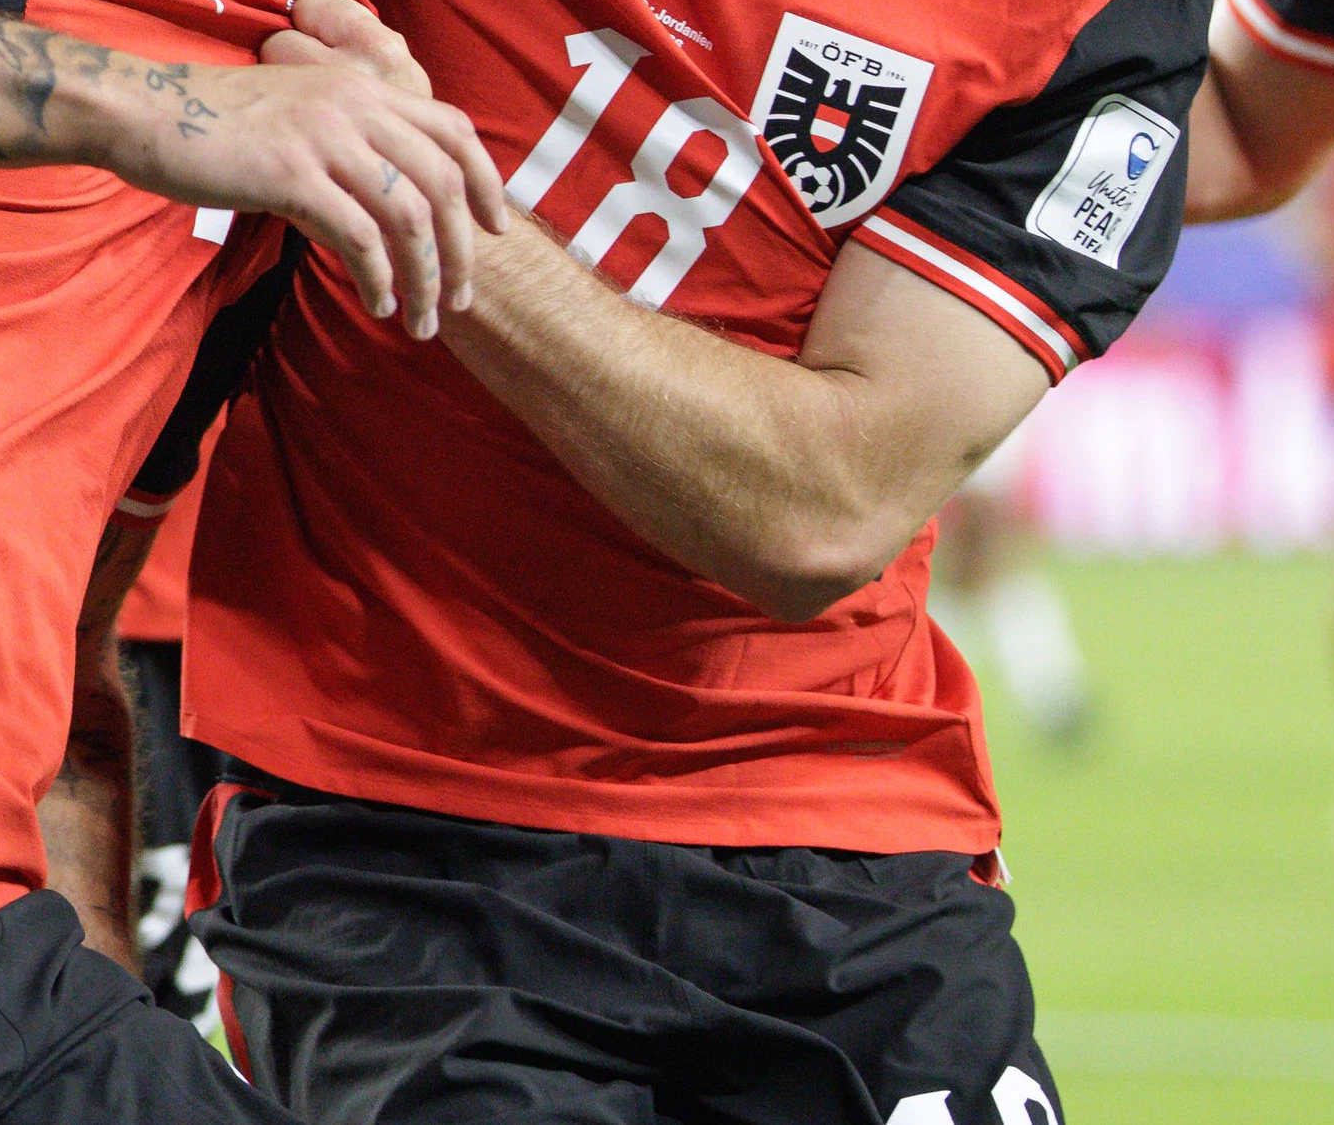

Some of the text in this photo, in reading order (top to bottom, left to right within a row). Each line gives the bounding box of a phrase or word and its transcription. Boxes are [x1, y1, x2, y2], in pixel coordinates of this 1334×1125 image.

[654, 8, 714, 51] Jordanien
[822, 41, 883, 77] ÖFB
[504, 27, 764, 310] 18
